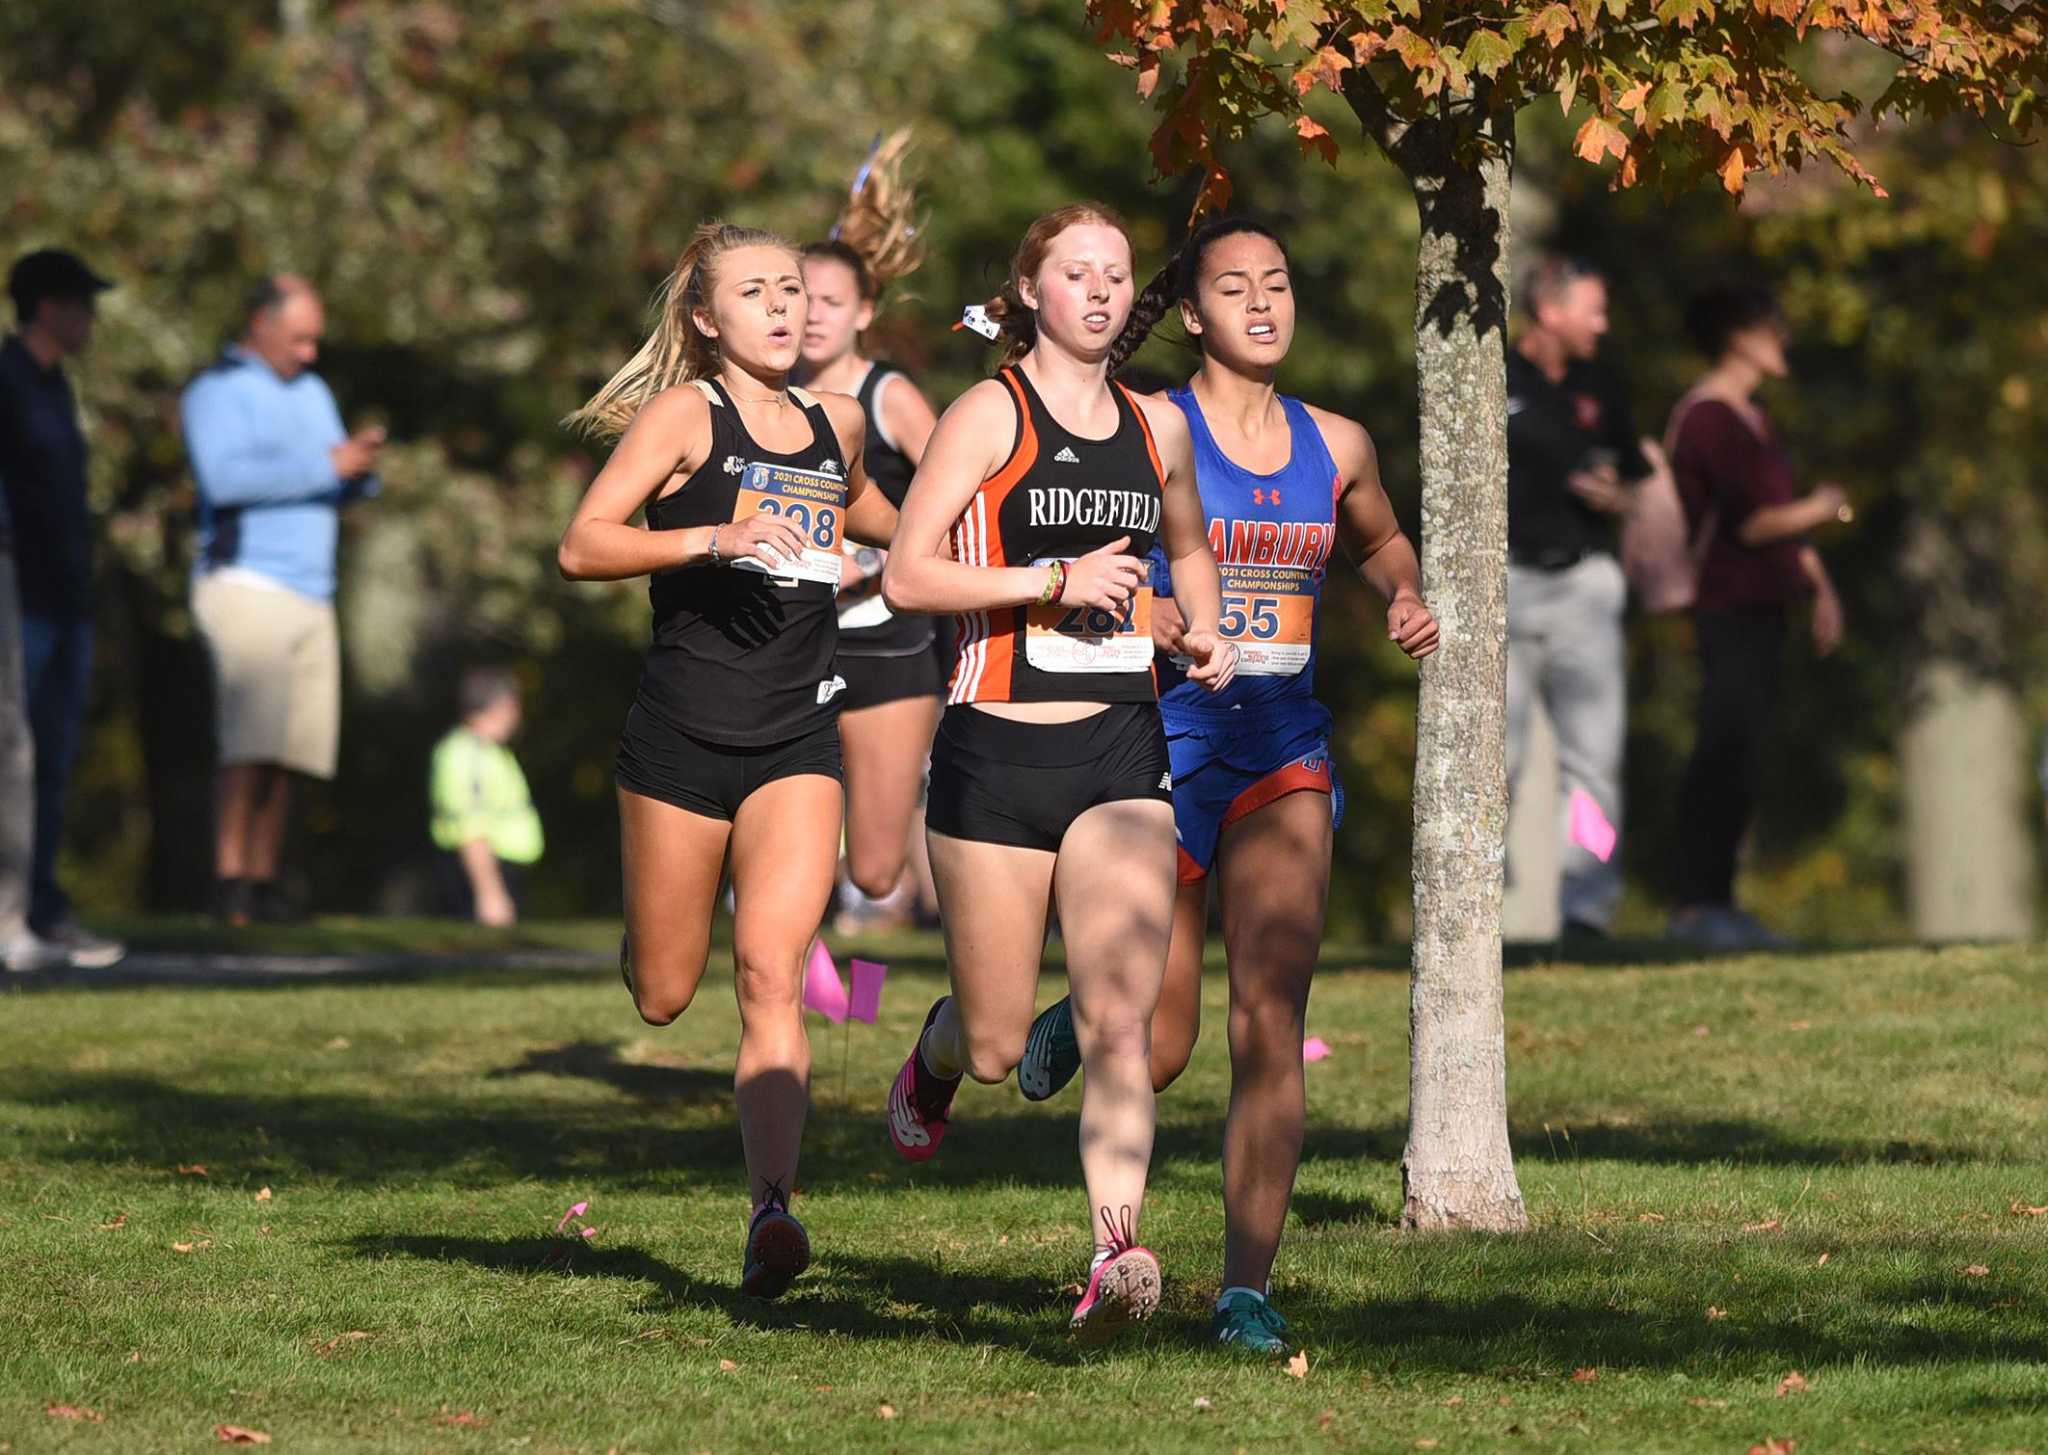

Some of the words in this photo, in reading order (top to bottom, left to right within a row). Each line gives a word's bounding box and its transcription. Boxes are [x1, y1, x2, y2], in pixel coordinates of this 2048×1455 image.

[773, 471, 793, 482] 2021
[794, 475, 819, 488] CROSS
[1028, 487, 1161, 534] RIDGEFIELD
[1207, 518, 1336, 570] ANBURY
[1219, 567, 1239, 577] 021
[1240, 568, 1271, 579] CROSS
[1272, 570, 1310, 581] COUNTRY
[1226, 578, 1300, 592] CHAMPIONSHIPS
